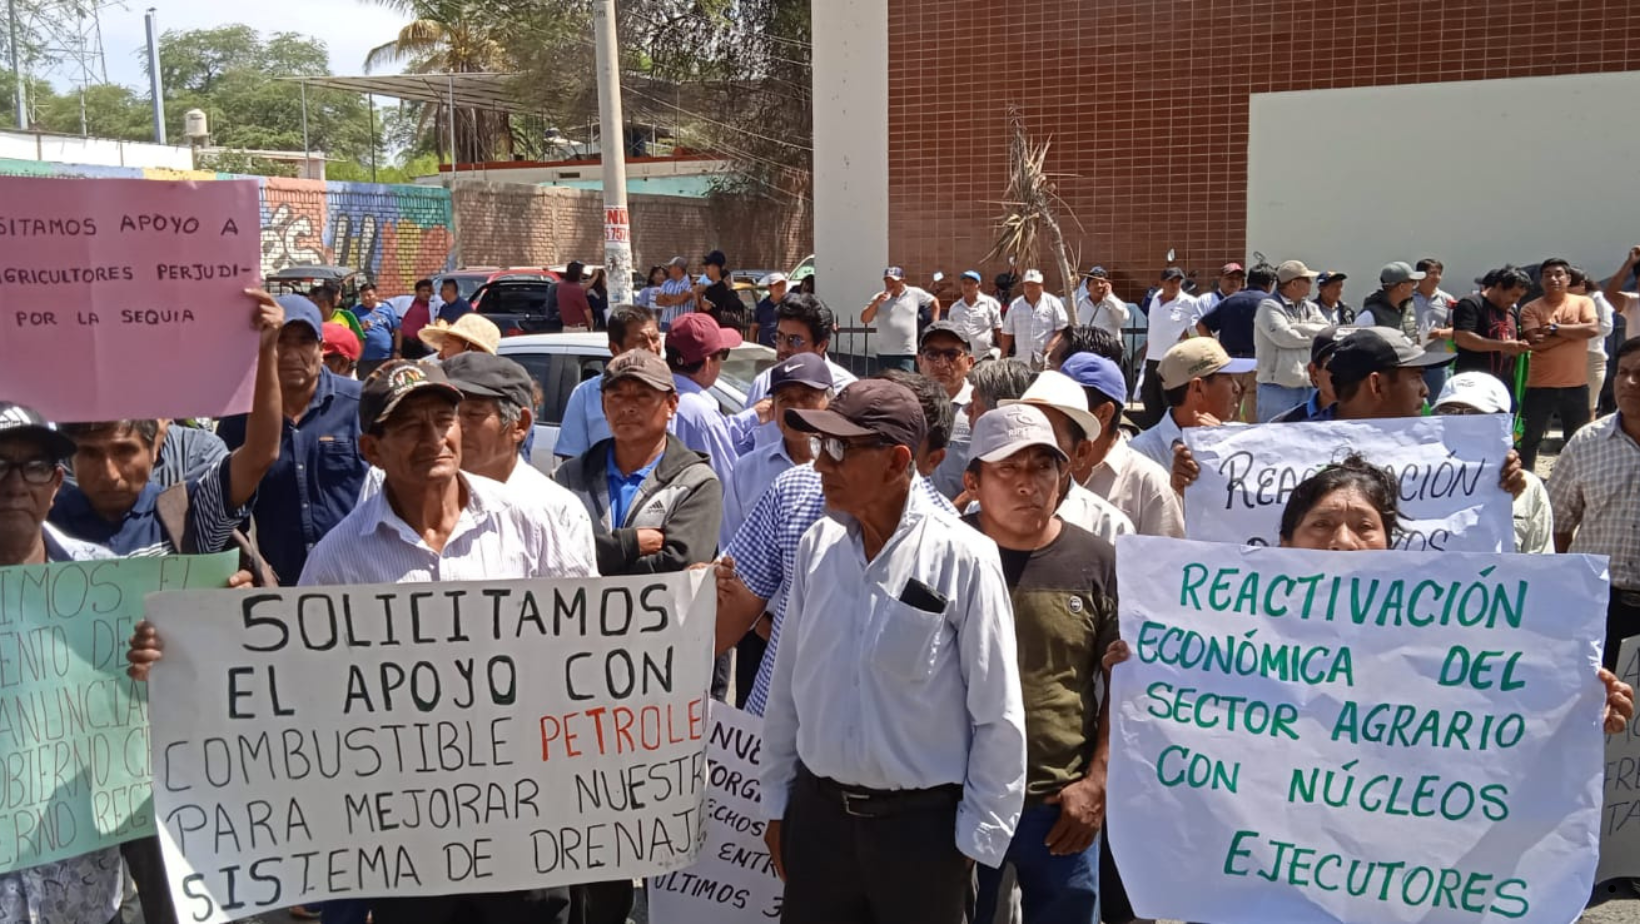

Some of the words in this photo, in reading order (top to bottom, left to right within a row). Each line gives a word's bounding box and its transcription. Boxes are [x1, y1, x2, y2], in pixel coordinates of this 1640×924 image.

[120, 214, 200, 235] APOYO
[221, 218, 239, 236] A
[0, 266, 133, 285] GRICULTORES
[157, 263, 252, 281] PERJUDI-
[16, 310, 58, 327] POR
[78, 311, 100, 326] LA
[121, 308, 195, 326] SEQUIA
[0, 560, 123, 627] IMOS
[242, 583, 669, 652] SOLICITAMOS
[1180, 563, 1528, 629] REACTIVACIÓN
[228, 666, 295, 719] EL
[343, 654, 517, 715] APOYO
[565, 645, 674, 701] CON
[1136, 620, 1353, 687] ECONÓMICA
[1437, 644, 1526, 692] DEL
[0, 677, 150, 747] ANUNCIA
[1145, 681, 1299, 740] SECTOR
[1331, 700, 1525, 751] AGRARIO
[164, 716, 514, 793] COMBUSTIBLE
[1156, 744, 1240, 794] CON
[1287, 759, 1509, 822] NÚCLEOS
[166, 798, 315, 857] PARA
[344, 777, 541, 836] MEJORAR
[182, 845, 422, 922] SISTEMA
[444, 838, 494, 882] DE
[1223, 830, 1529, 919] EJECUTORES
